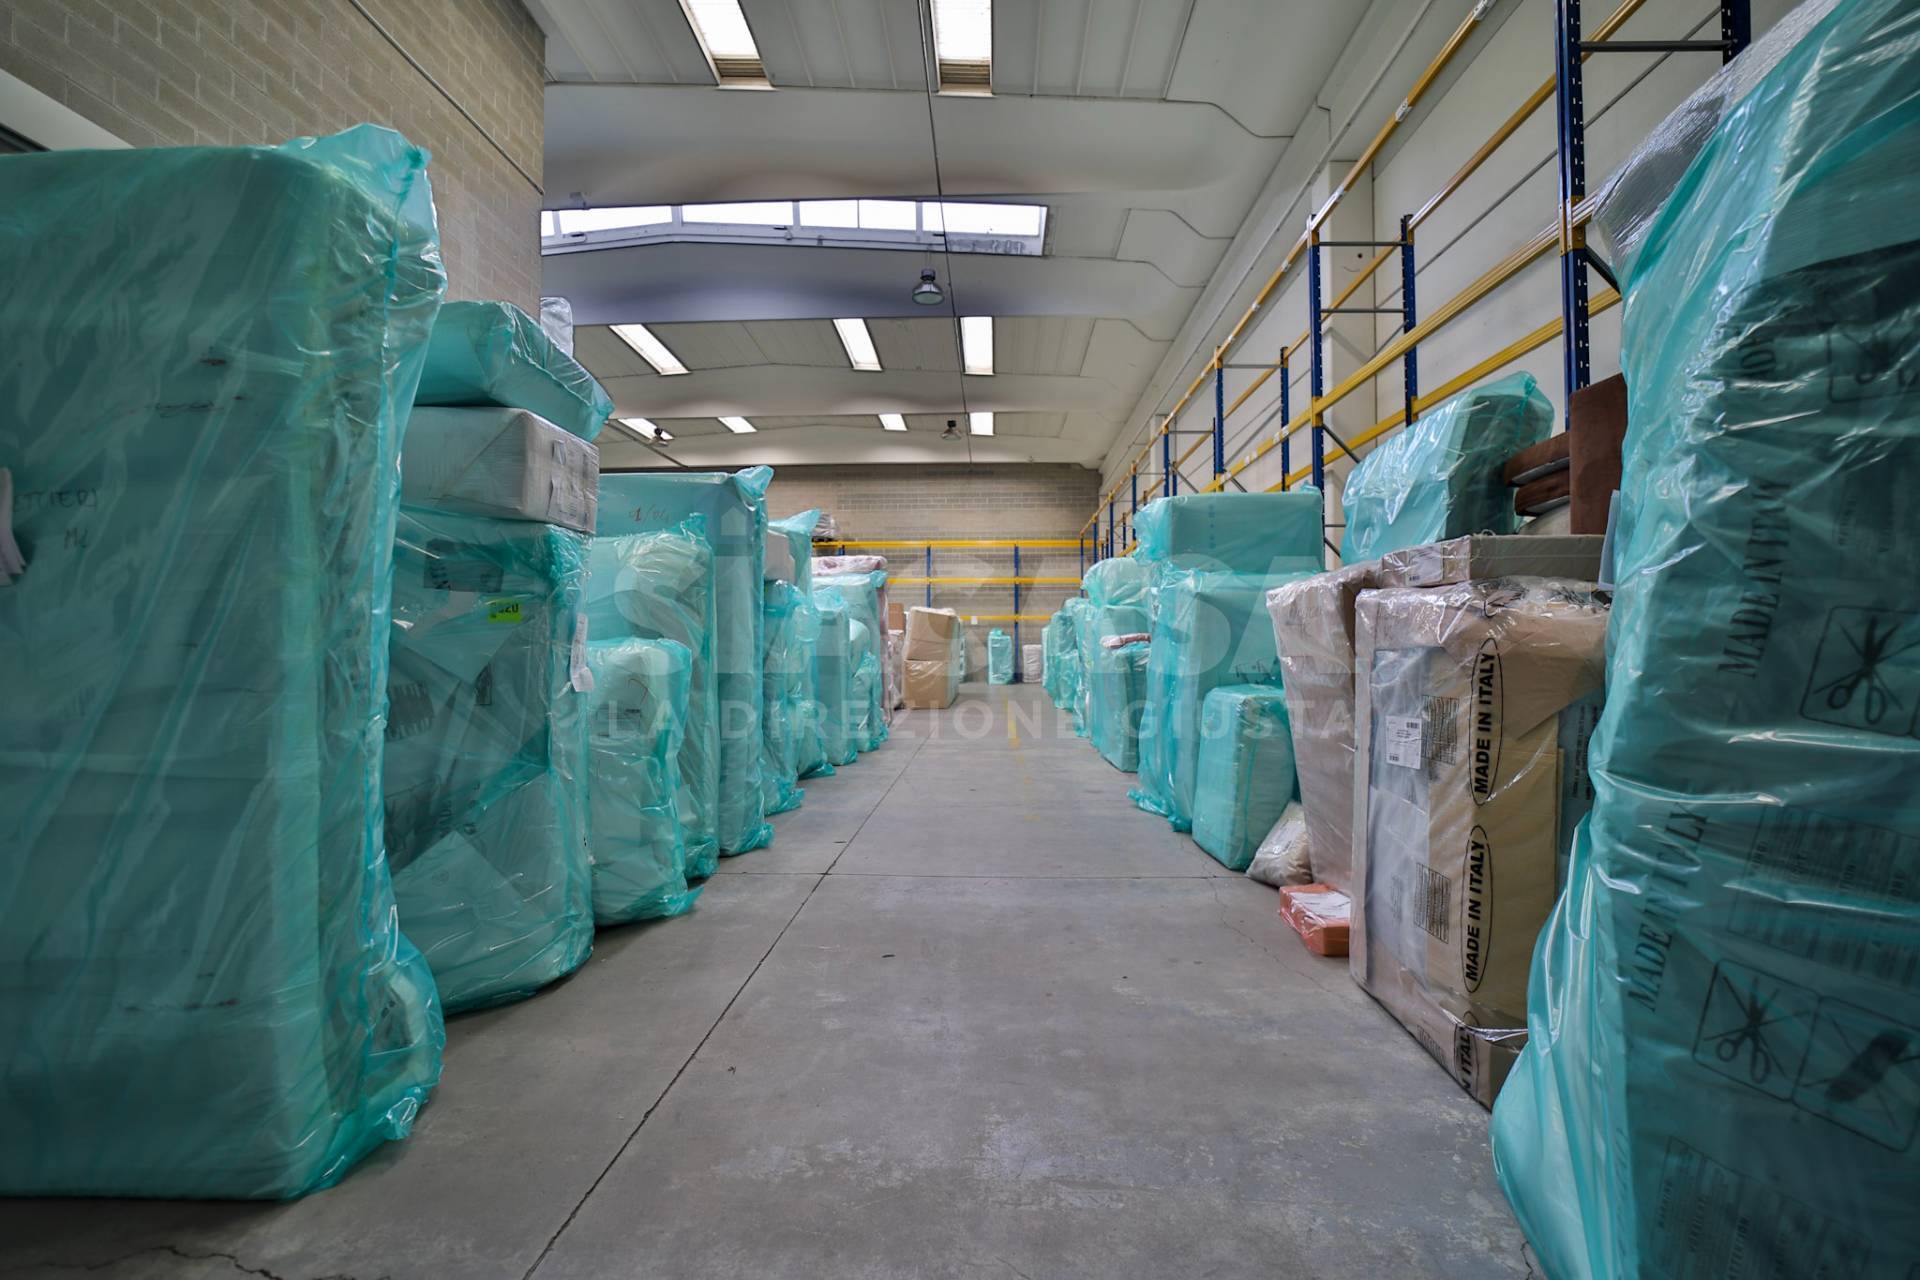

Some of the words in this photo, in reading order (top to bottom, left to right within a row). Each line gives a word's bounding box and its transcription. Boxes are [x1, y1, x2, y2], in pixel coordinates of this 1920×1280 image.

[1718, 592, 1780, 680] MADE
[1478, 652, 1496, 705] ITALY
[1477, 711, 1492, 733] IN
[1474, 738, 1491, 794] MADE
[1470, 840, 1485, 894] ITALY
[1468, 898, 1482, 921] IN
[1465, 924, 1480, 982] MADE
[1627, 922, 1674, 1013] MADE
